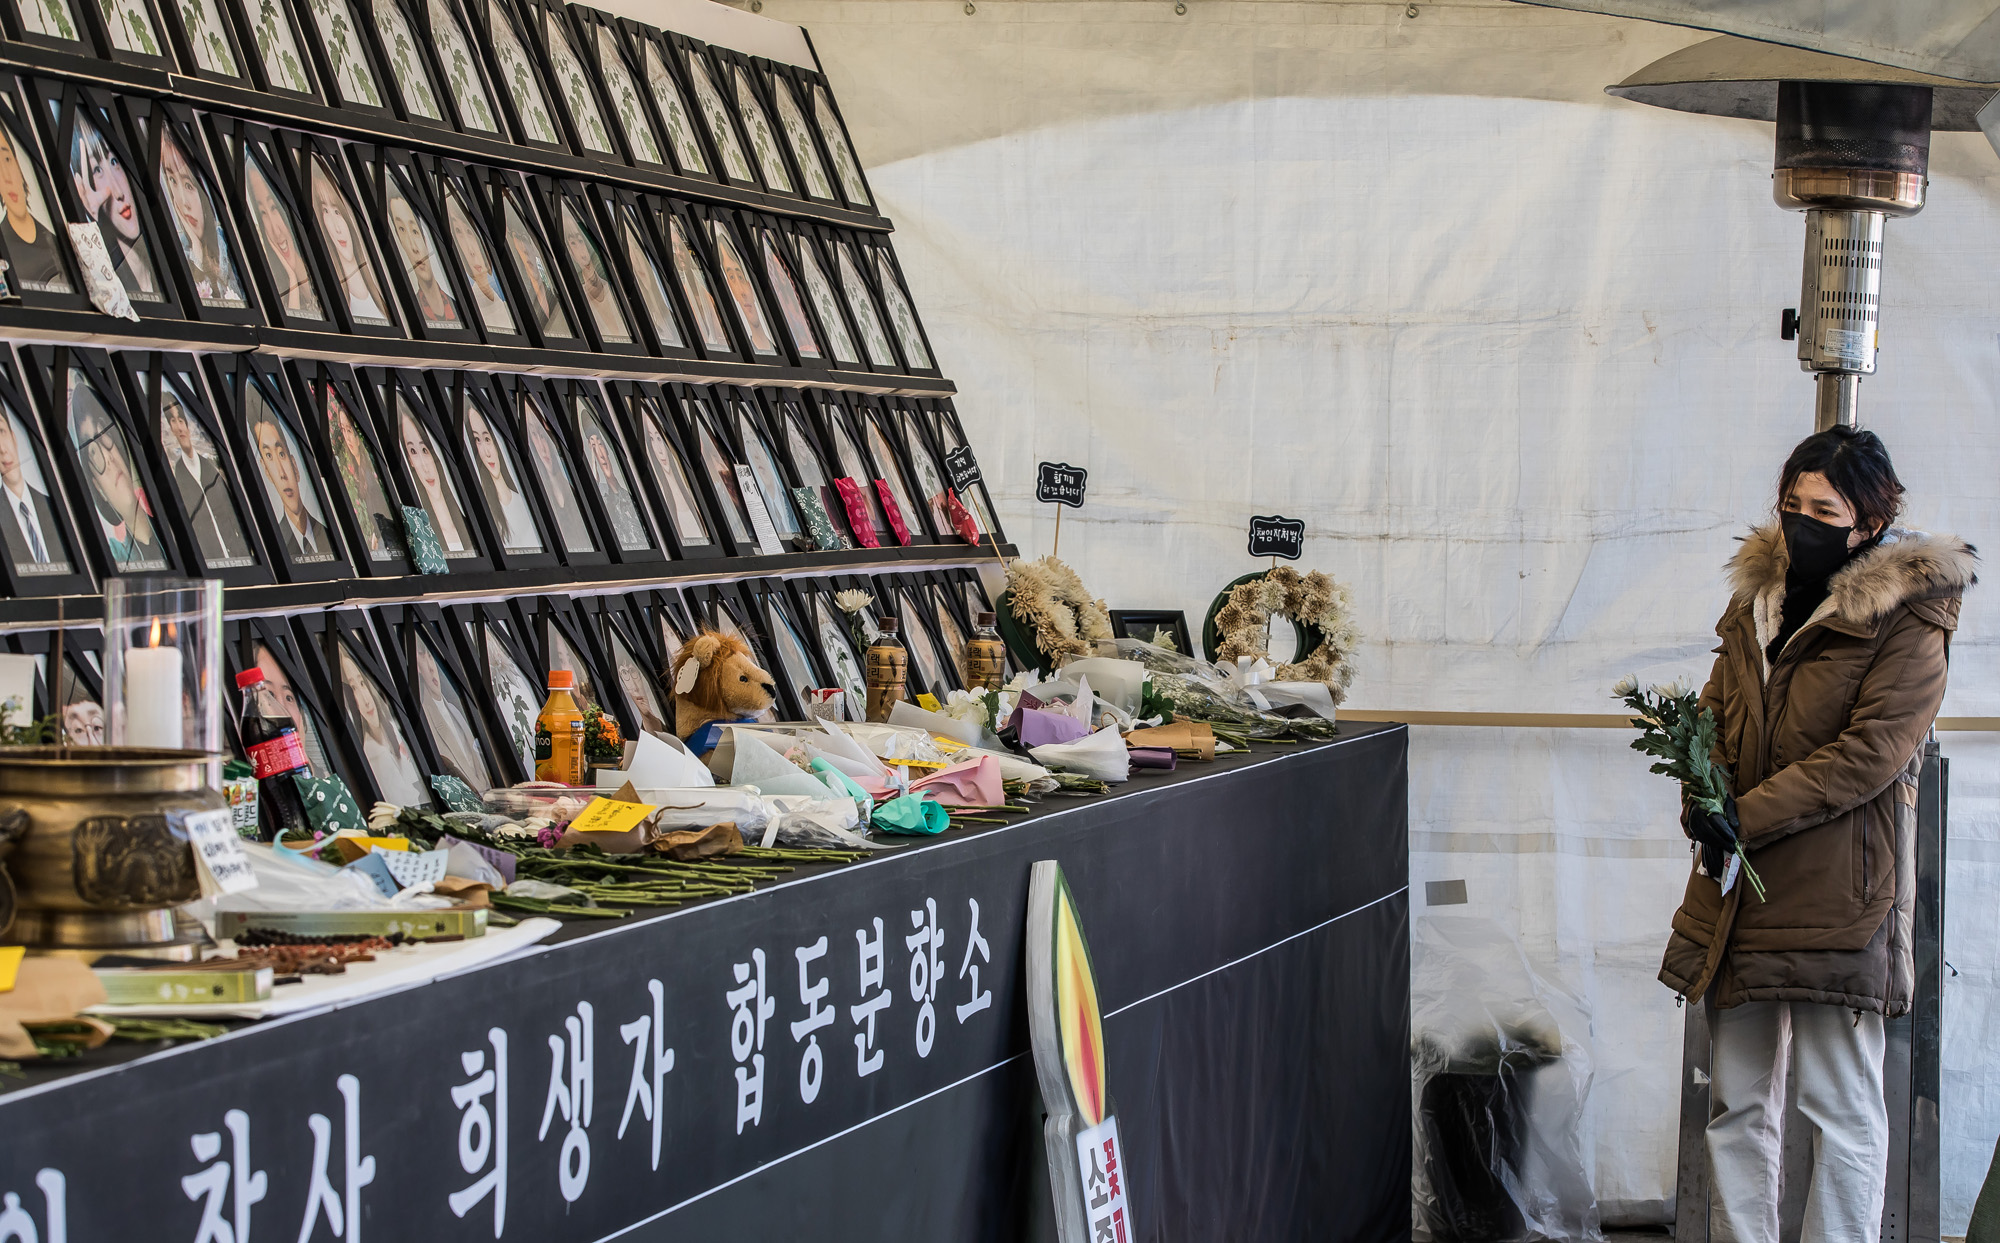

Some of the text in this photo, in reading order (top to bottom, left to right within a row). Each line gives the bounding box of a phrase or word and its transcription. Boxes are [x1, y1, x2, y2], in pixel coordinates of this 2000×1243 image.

[954, 456, 967, 468] 기억
[1053, 471, 1075, 485] 함께
[1043, 484, 1080, 497] 하겠습니다
[448, 978, 675, 1239] 희생자
[726, 897, 992, 1135] 합동분향소
